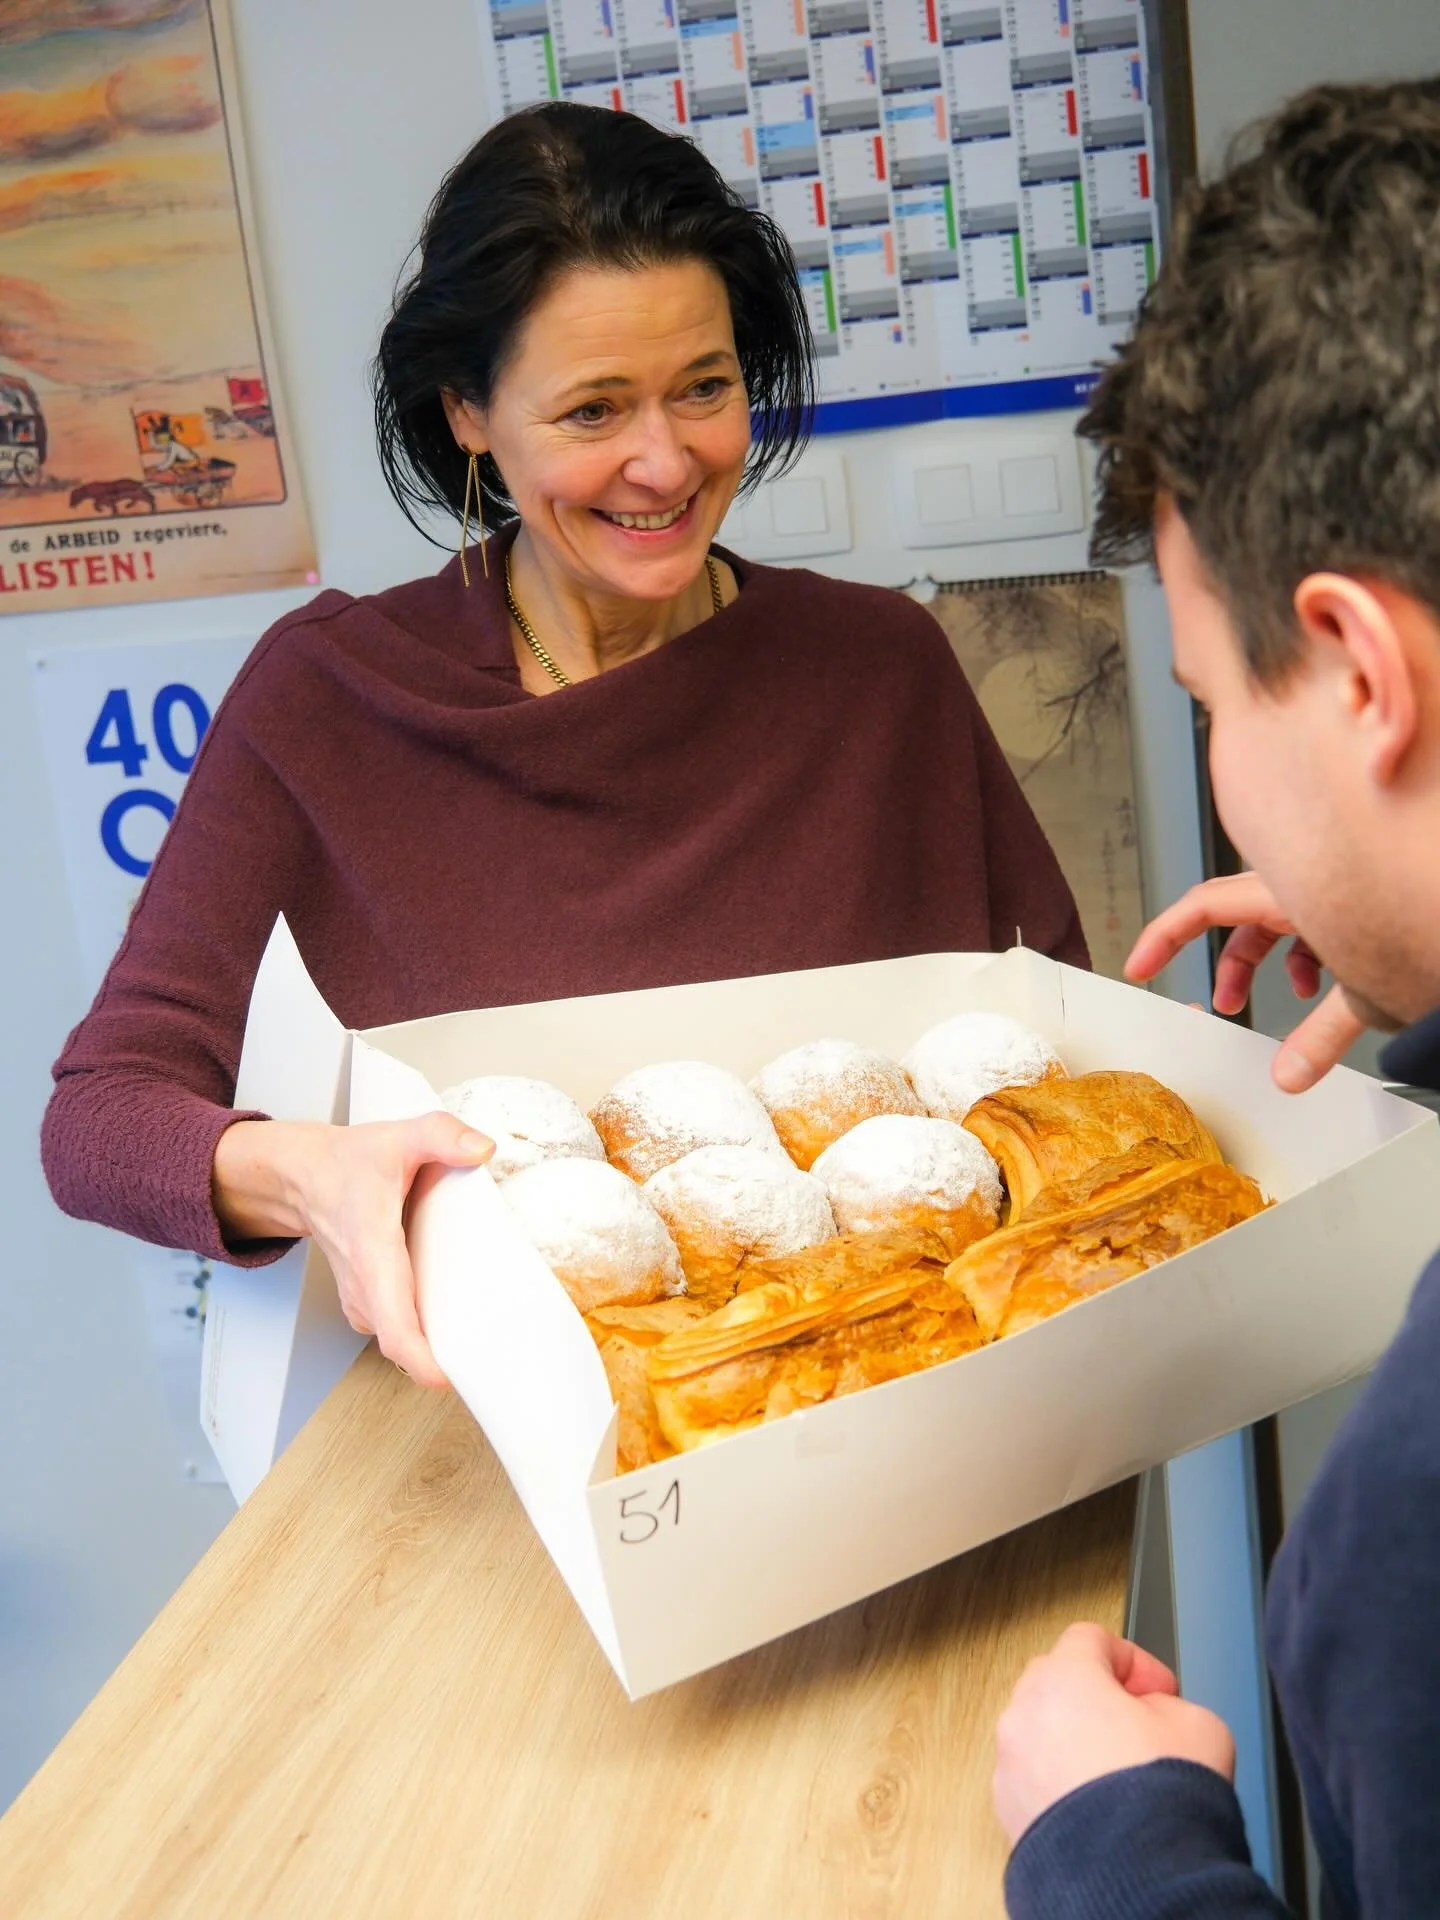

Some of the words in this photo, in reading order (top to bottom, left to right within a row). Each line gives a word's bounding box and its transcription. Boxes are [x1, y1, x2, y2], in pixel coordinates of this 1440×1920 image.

[9, 538, 31, 554] de
[44, 530, 121, 552] ARBEID
[86, 683, 212, 778] 40
[619, 1478, 681, 1544] 51
